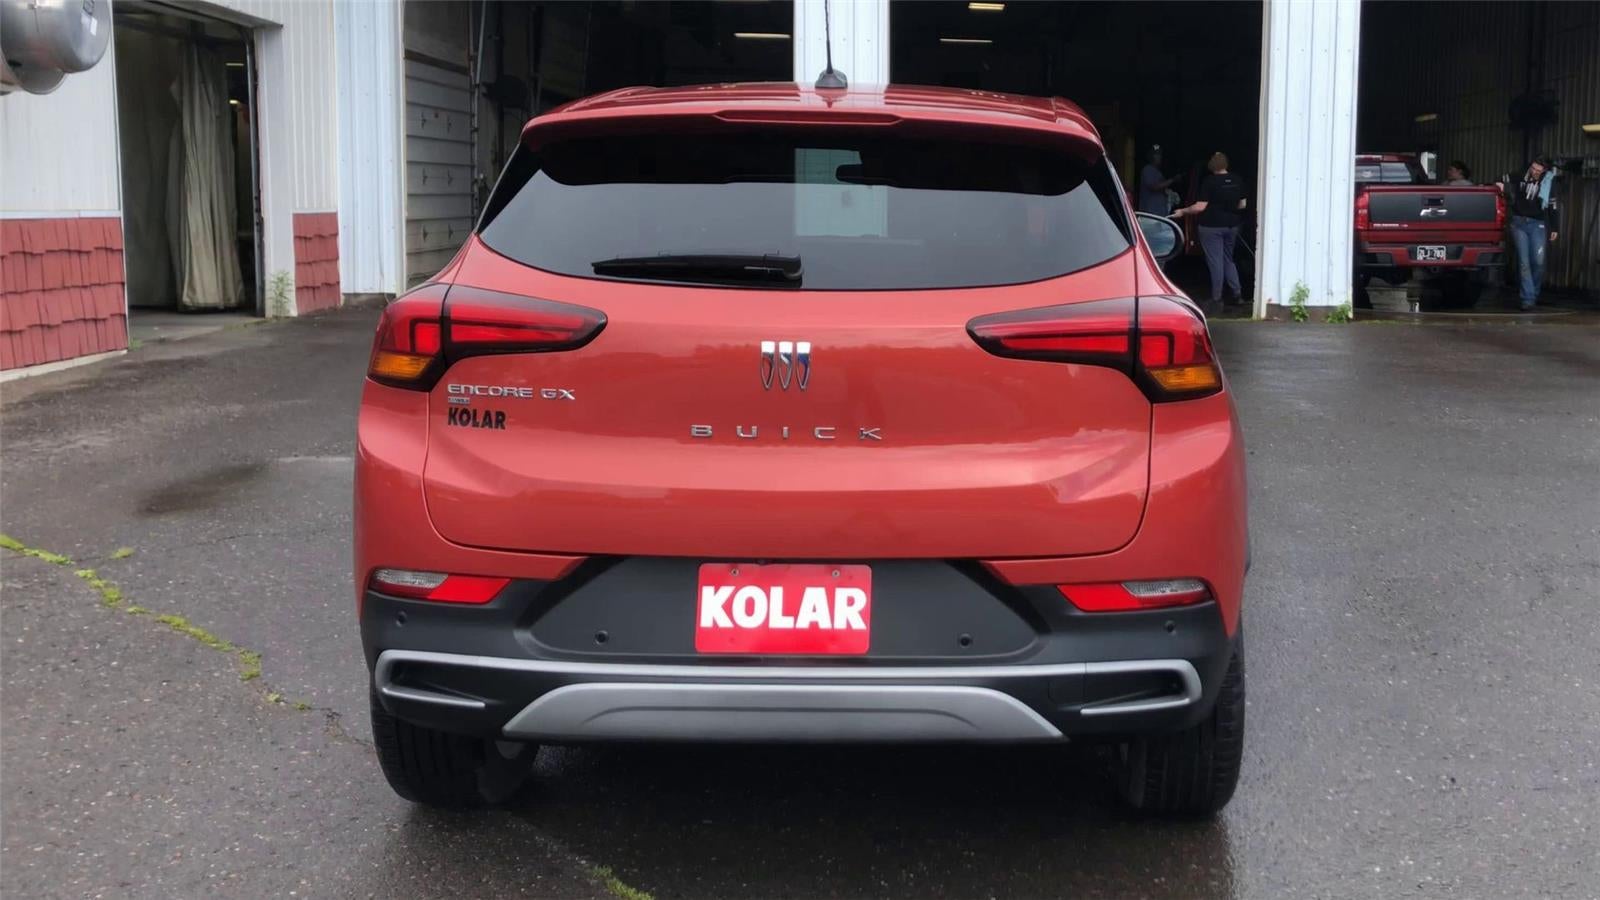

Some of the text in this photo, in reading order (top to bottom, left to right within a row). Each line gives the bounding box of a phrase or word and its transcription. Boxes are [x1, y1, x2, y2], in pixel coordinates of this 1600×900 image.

[447, 383, 576, 400] ENCORE GX
[448, 407, 506, 429] KOLAR
[691, 424, 882, 440] BUICK
[700, 585, 867, 630] KOLAR
